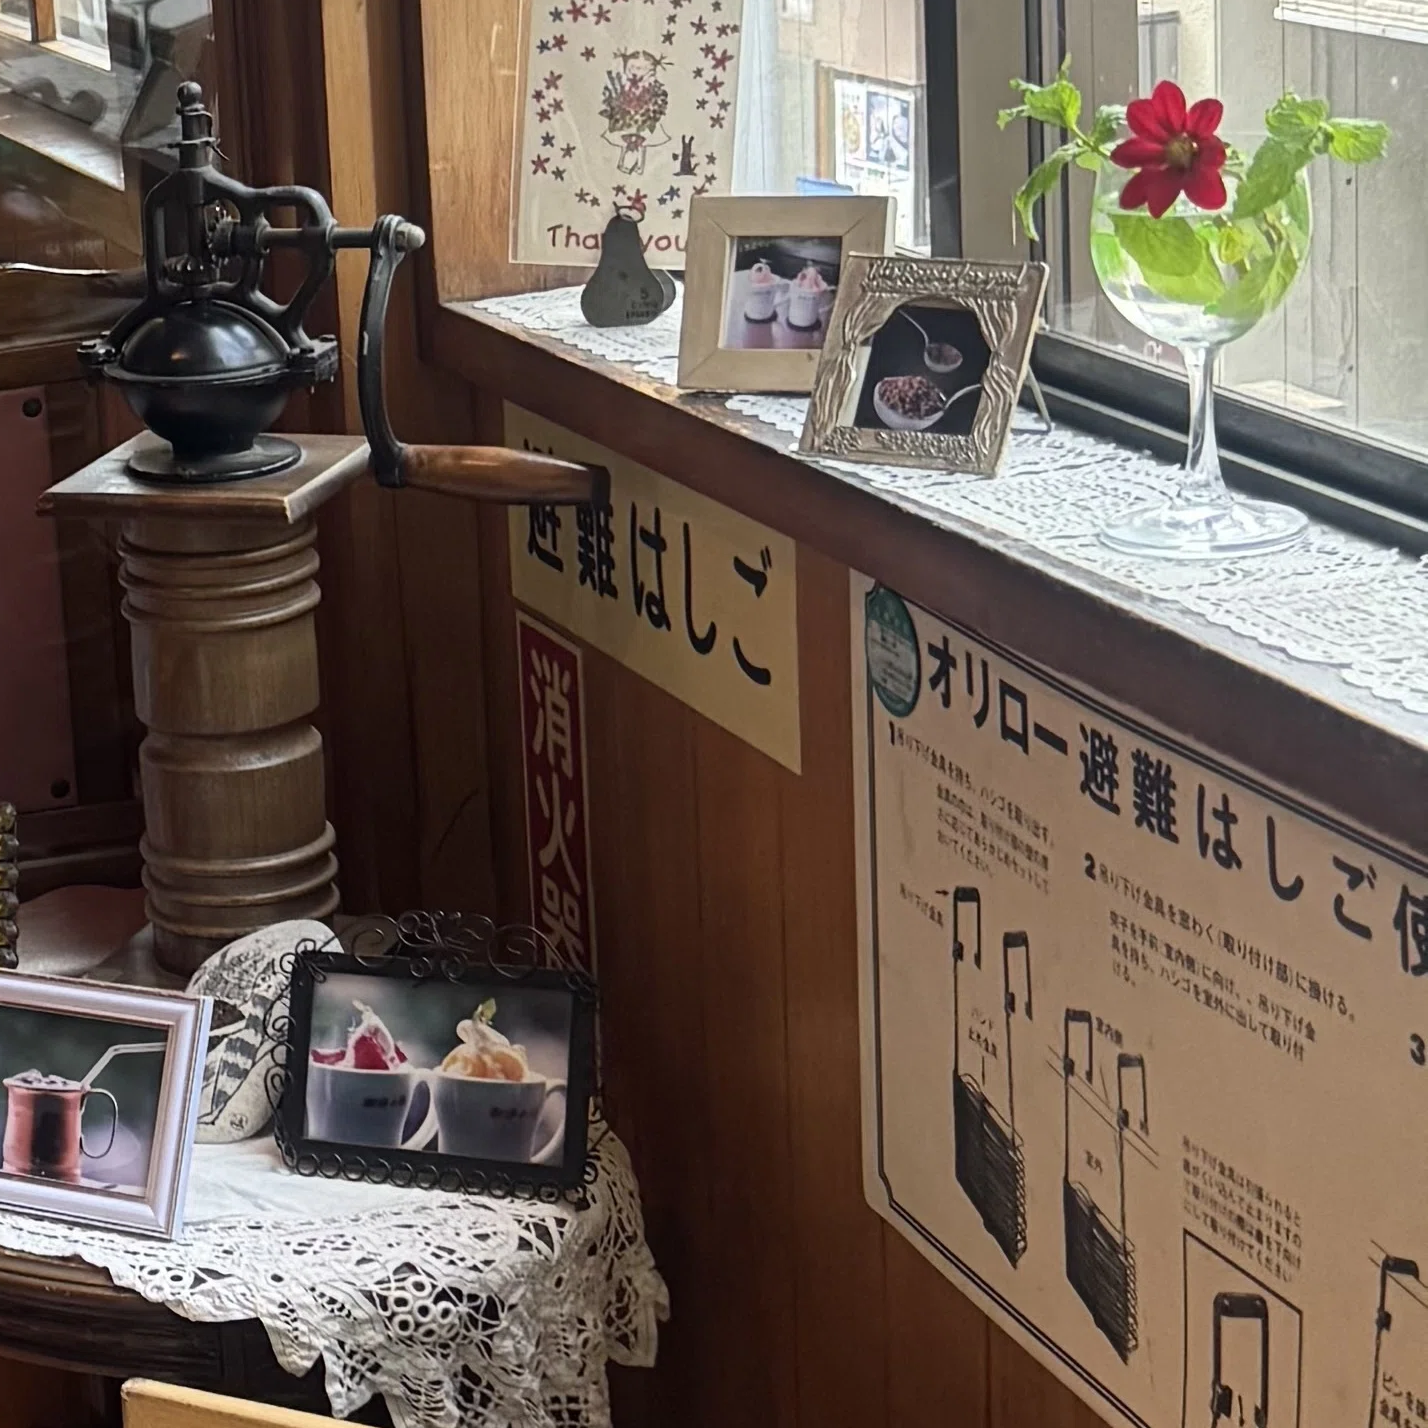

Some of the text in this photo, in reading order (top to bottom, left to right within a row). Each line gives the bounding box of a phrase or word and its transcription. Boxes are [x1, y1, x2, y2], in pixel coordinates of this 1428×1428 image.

[547, 224, 605, 250] Tha
[1084, 852, 1097, 880] 2
[1410, 1032, 1426, 1066] 3
